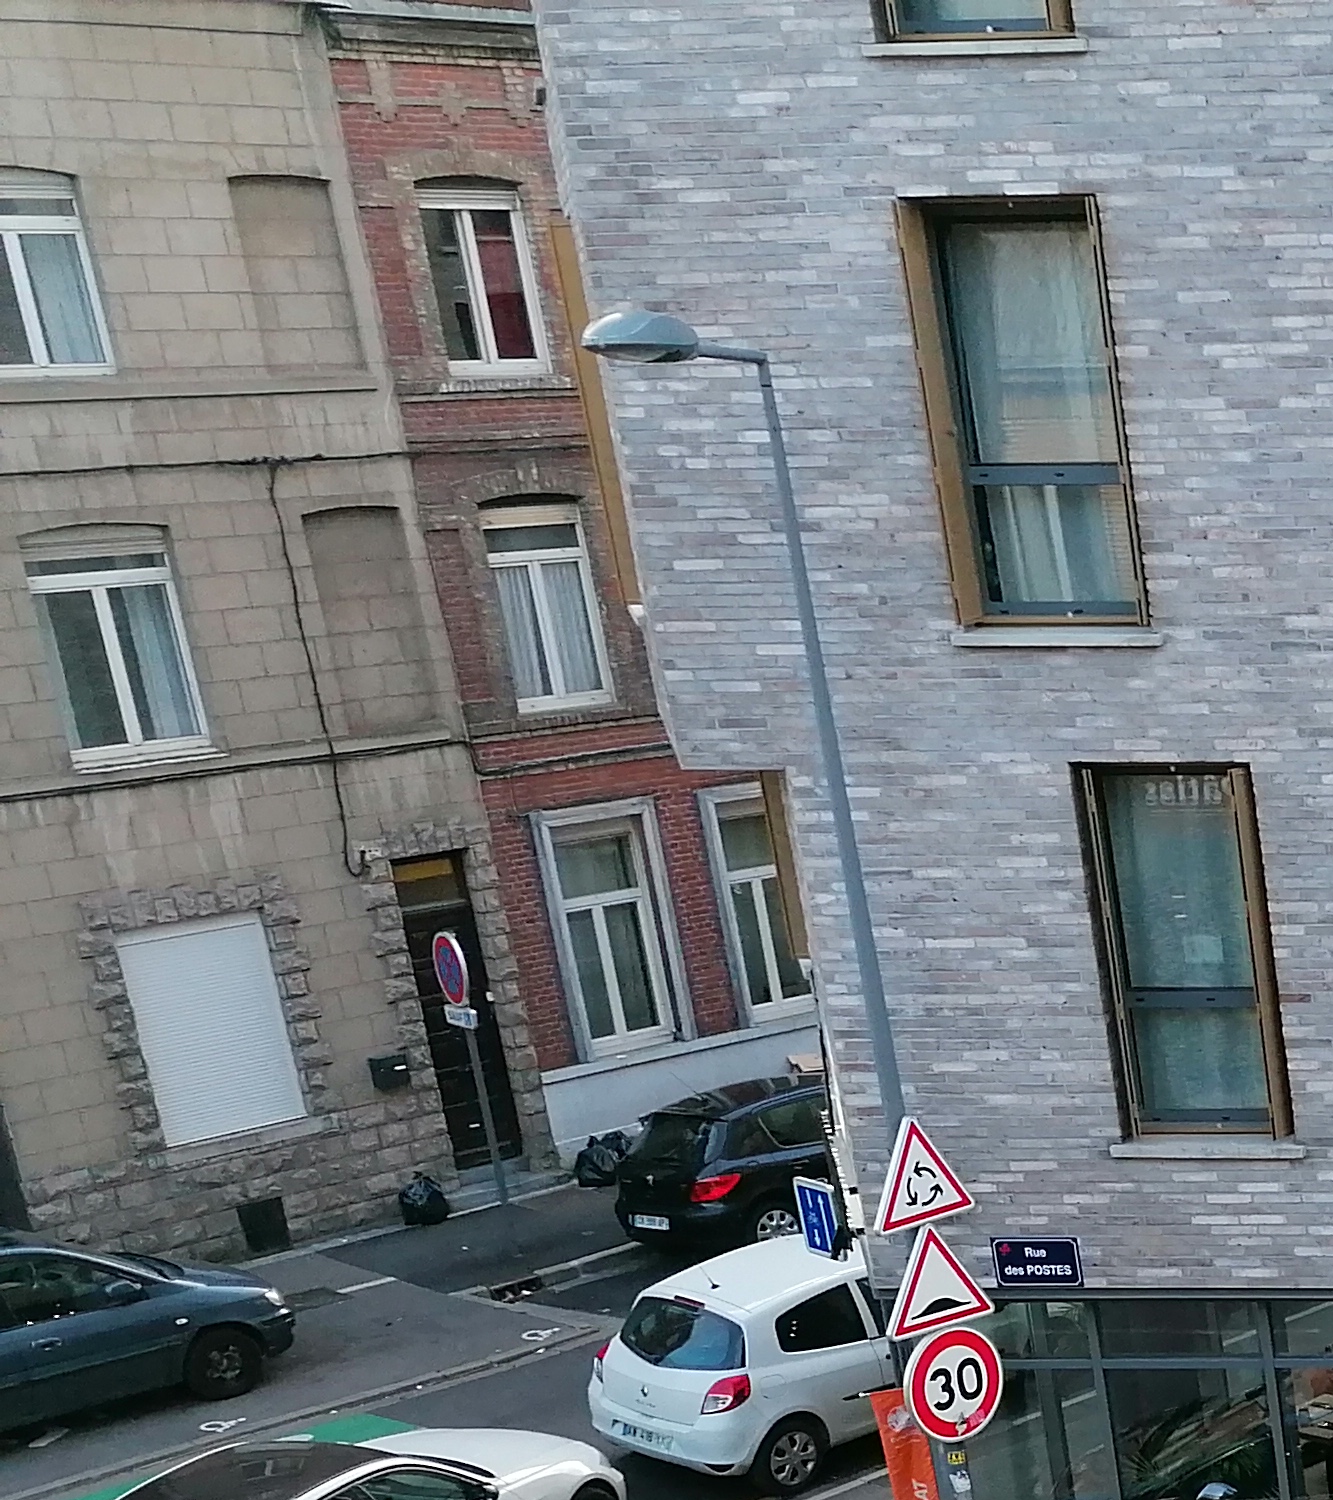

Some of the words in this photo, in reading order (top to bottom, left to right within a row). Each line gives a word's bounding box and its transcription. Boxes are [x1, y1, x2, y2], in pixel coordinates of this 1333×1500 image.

[1024, 1247, 1047, 1258] Rue
[1004, 1265, 1025, 1275] des
[1026, 1265, 1072, 1276] POSTES
[930, 1357, 983, 1411] 30
